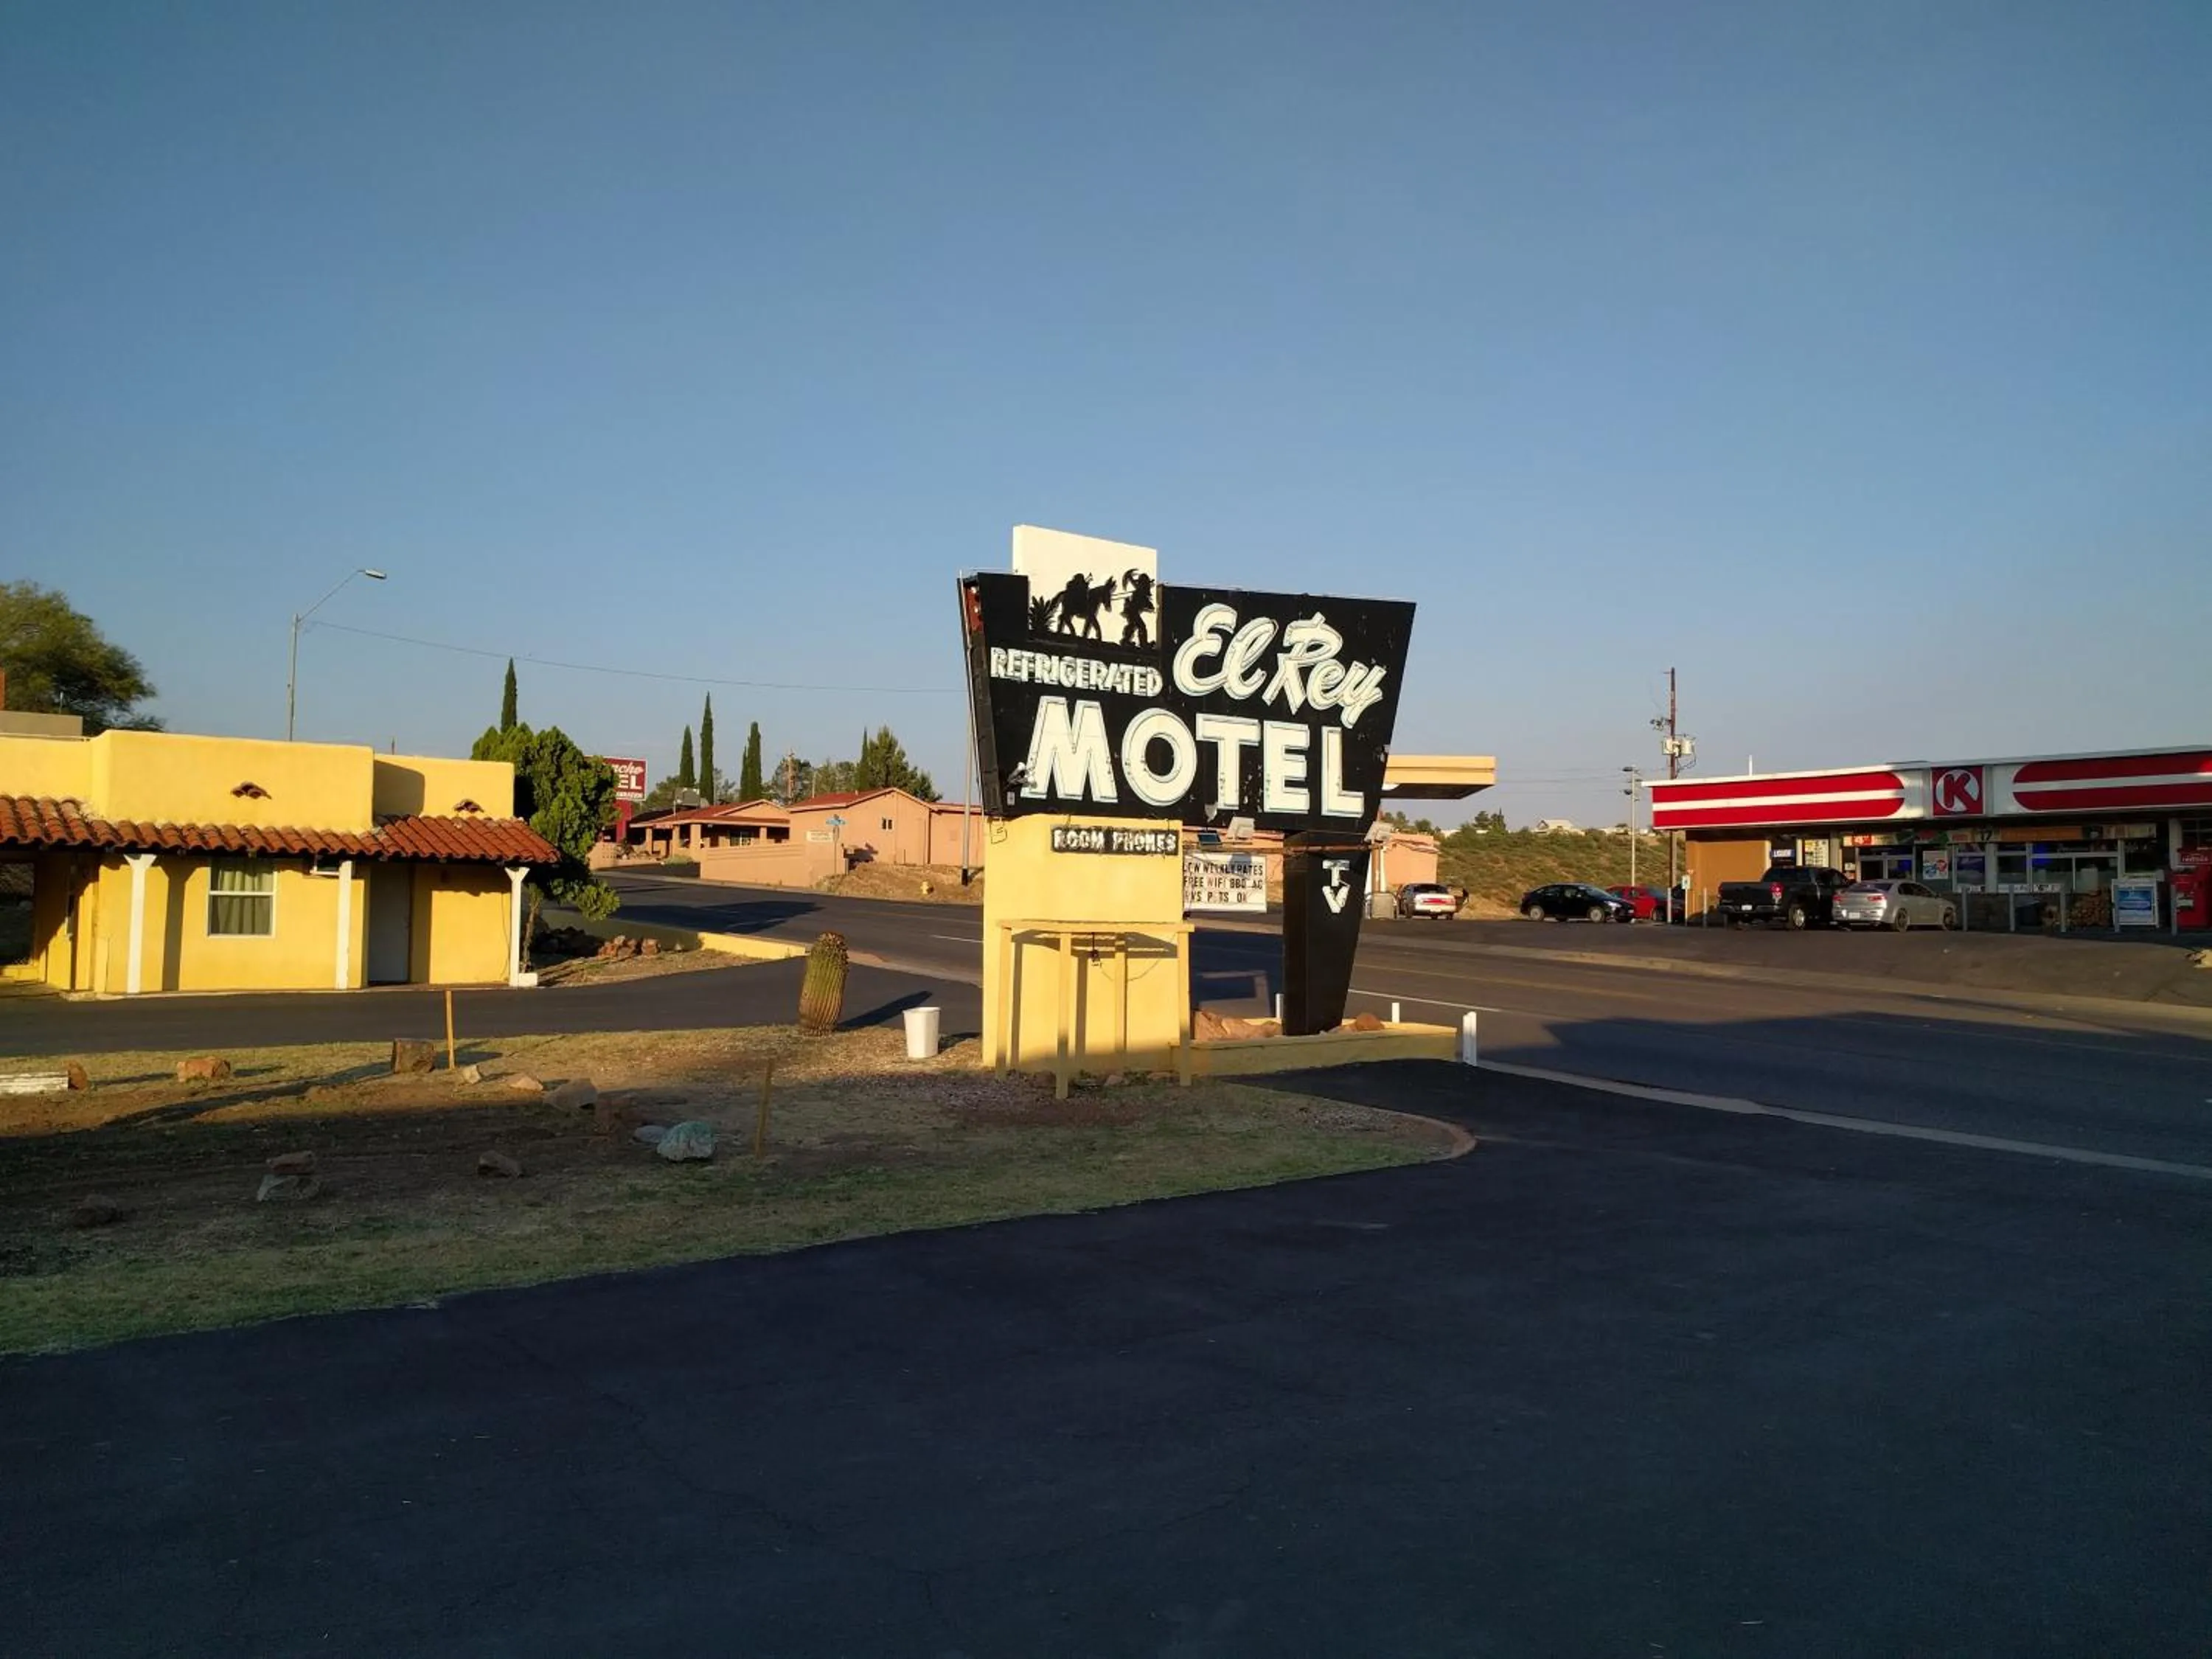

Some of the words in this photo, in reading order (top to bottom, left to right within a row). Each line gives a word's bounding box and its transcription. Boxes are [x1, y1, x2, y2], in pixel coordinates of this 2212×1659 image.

[990, 646, 1164, 697] REFRIGERATED
[1174, 602, 1279, 700] El
[1262, 611, 1388, 728] Rey
[1020, 695, 1365, 818] MOTEL
[1943, 774, 1970, 808] K
[1054, 829, 1105, 849] ROOM
[1113, 831, 1177, 852] PHONES
[1183, 875, 1203, 888] FREE
[1207, 891, 1229, 903] PTS
[1322, 860, 1351, 914] TV
